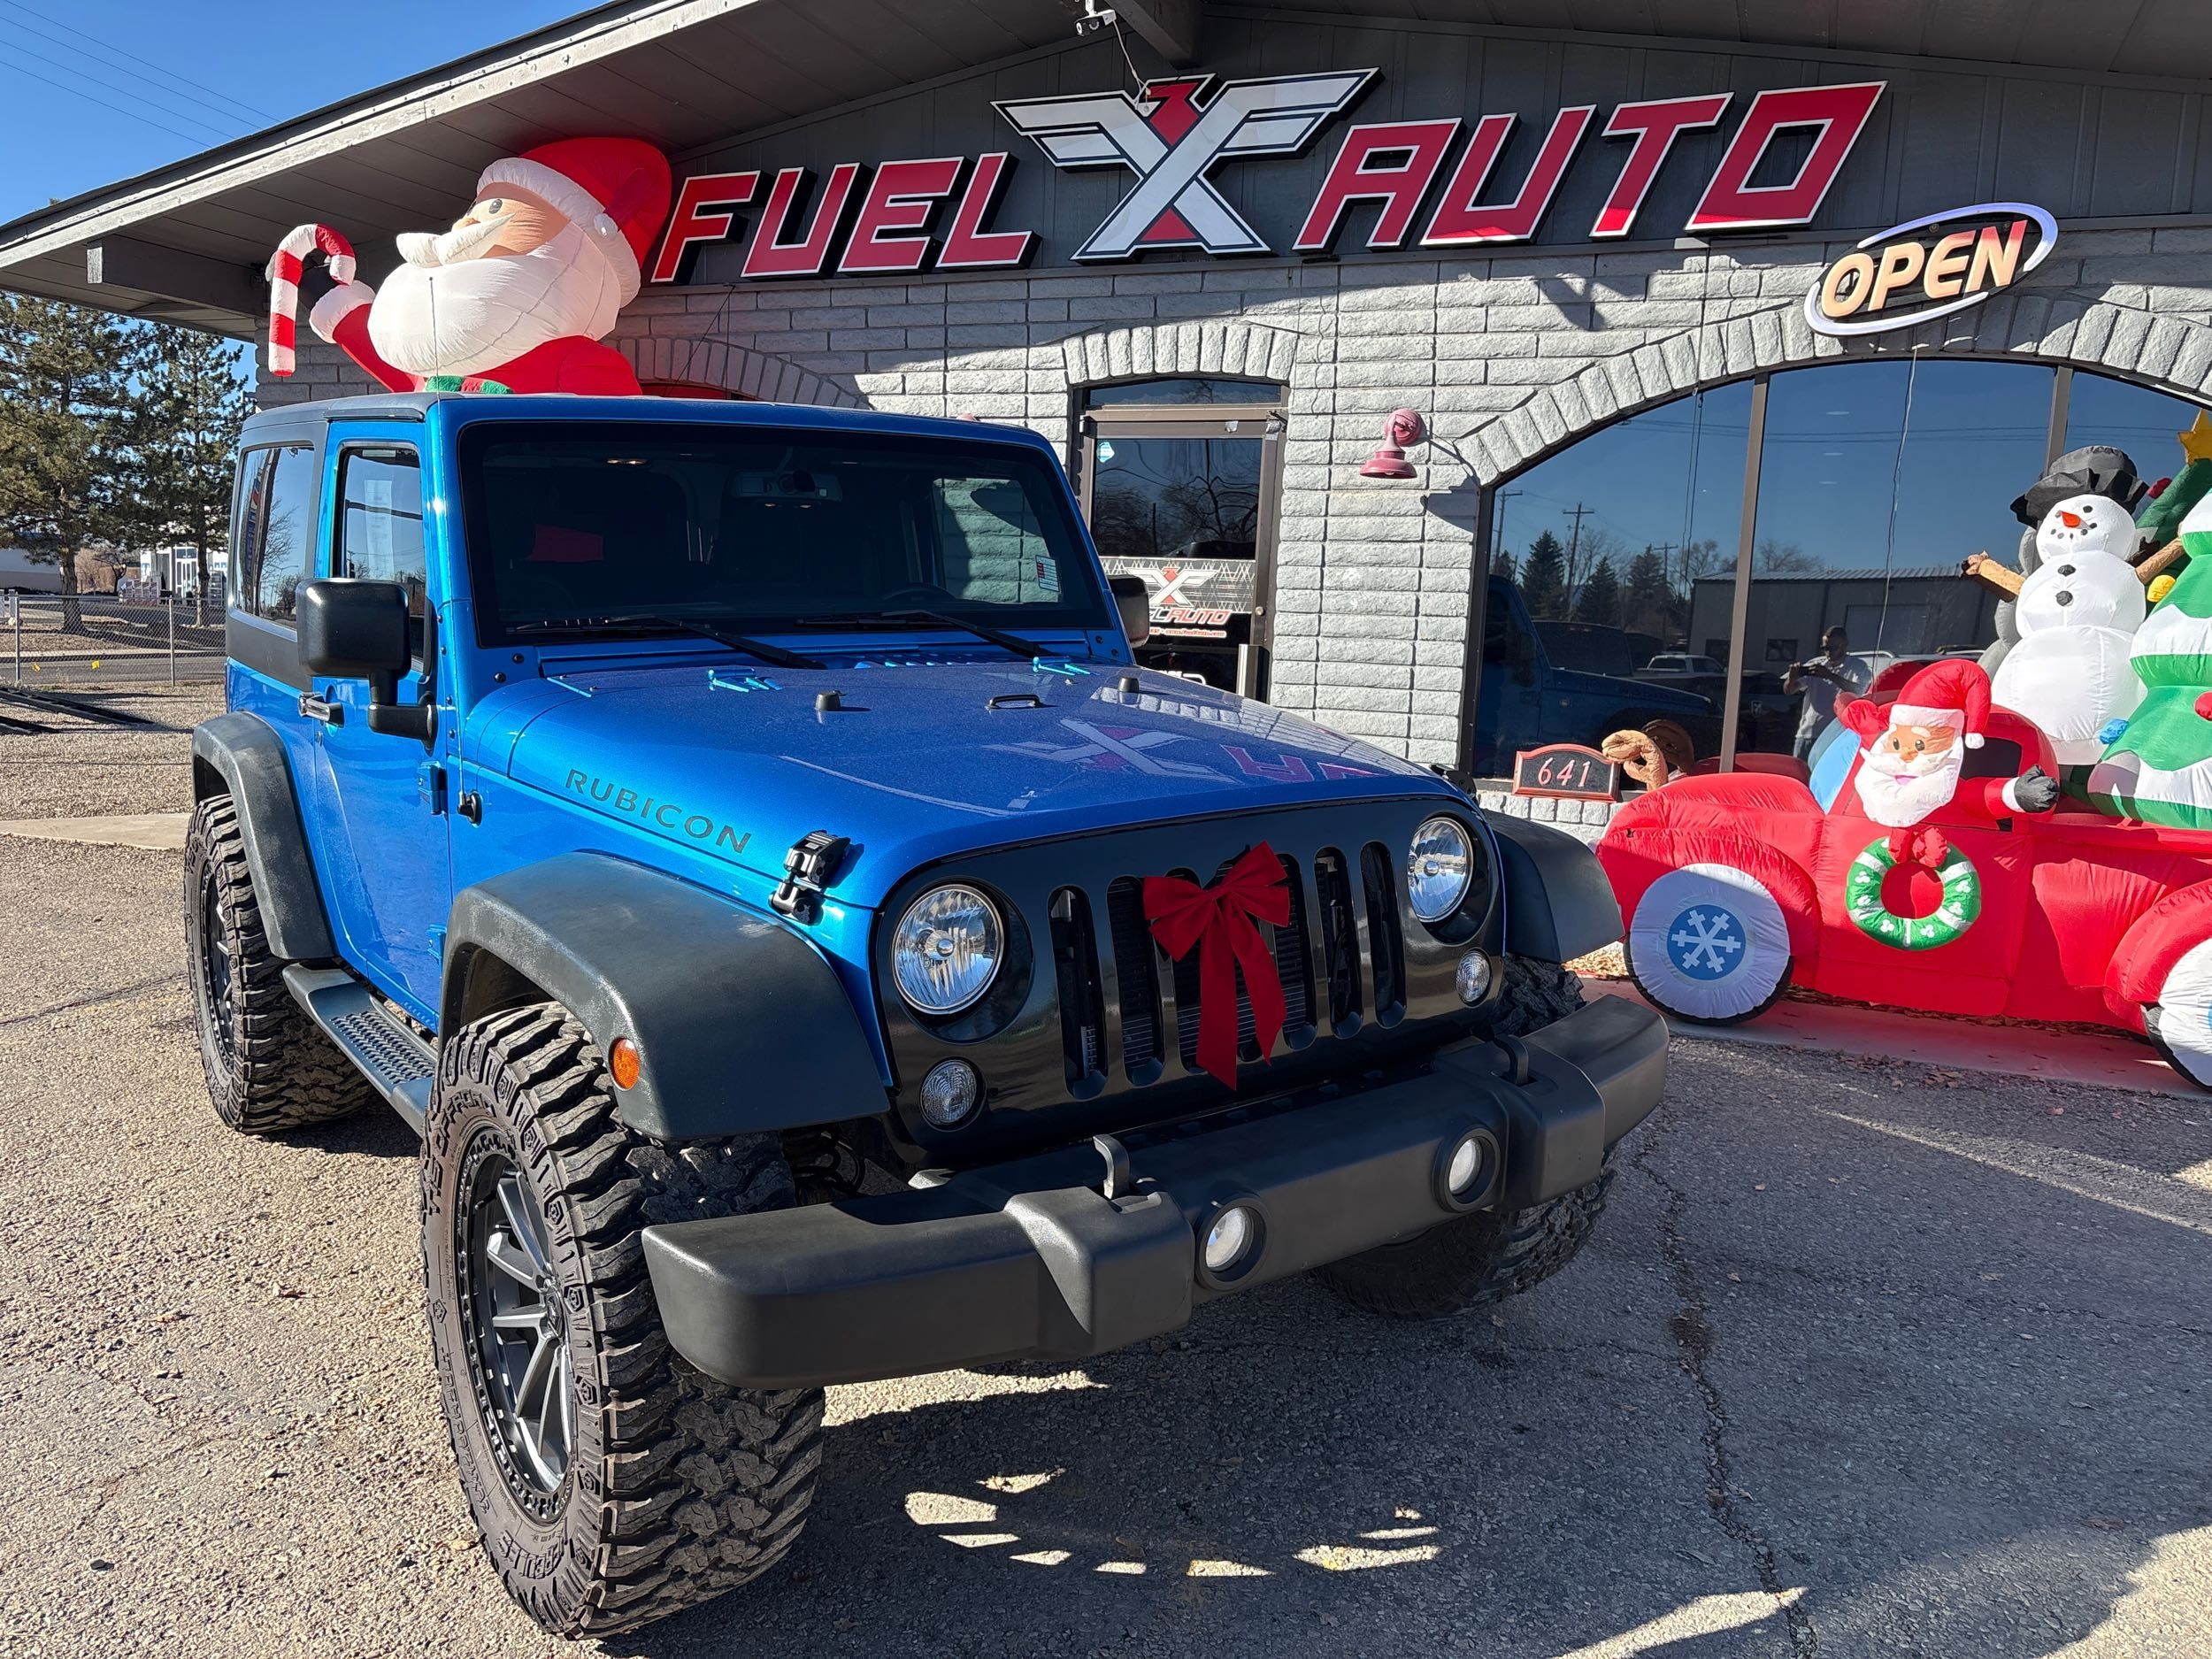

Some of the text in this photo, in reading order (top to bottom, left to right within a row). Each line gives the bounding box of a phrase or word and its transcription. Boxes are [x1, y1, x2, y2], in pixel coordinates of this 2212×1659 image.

[651, 151, 1033, 283] FUEL
[1293, 80, 1888, 251] AUTO
[1821, 219, 2028, 319] OPEN
[566, 769, 751, 854] RUBICON
[1538, 757, 1592, 787] 641
